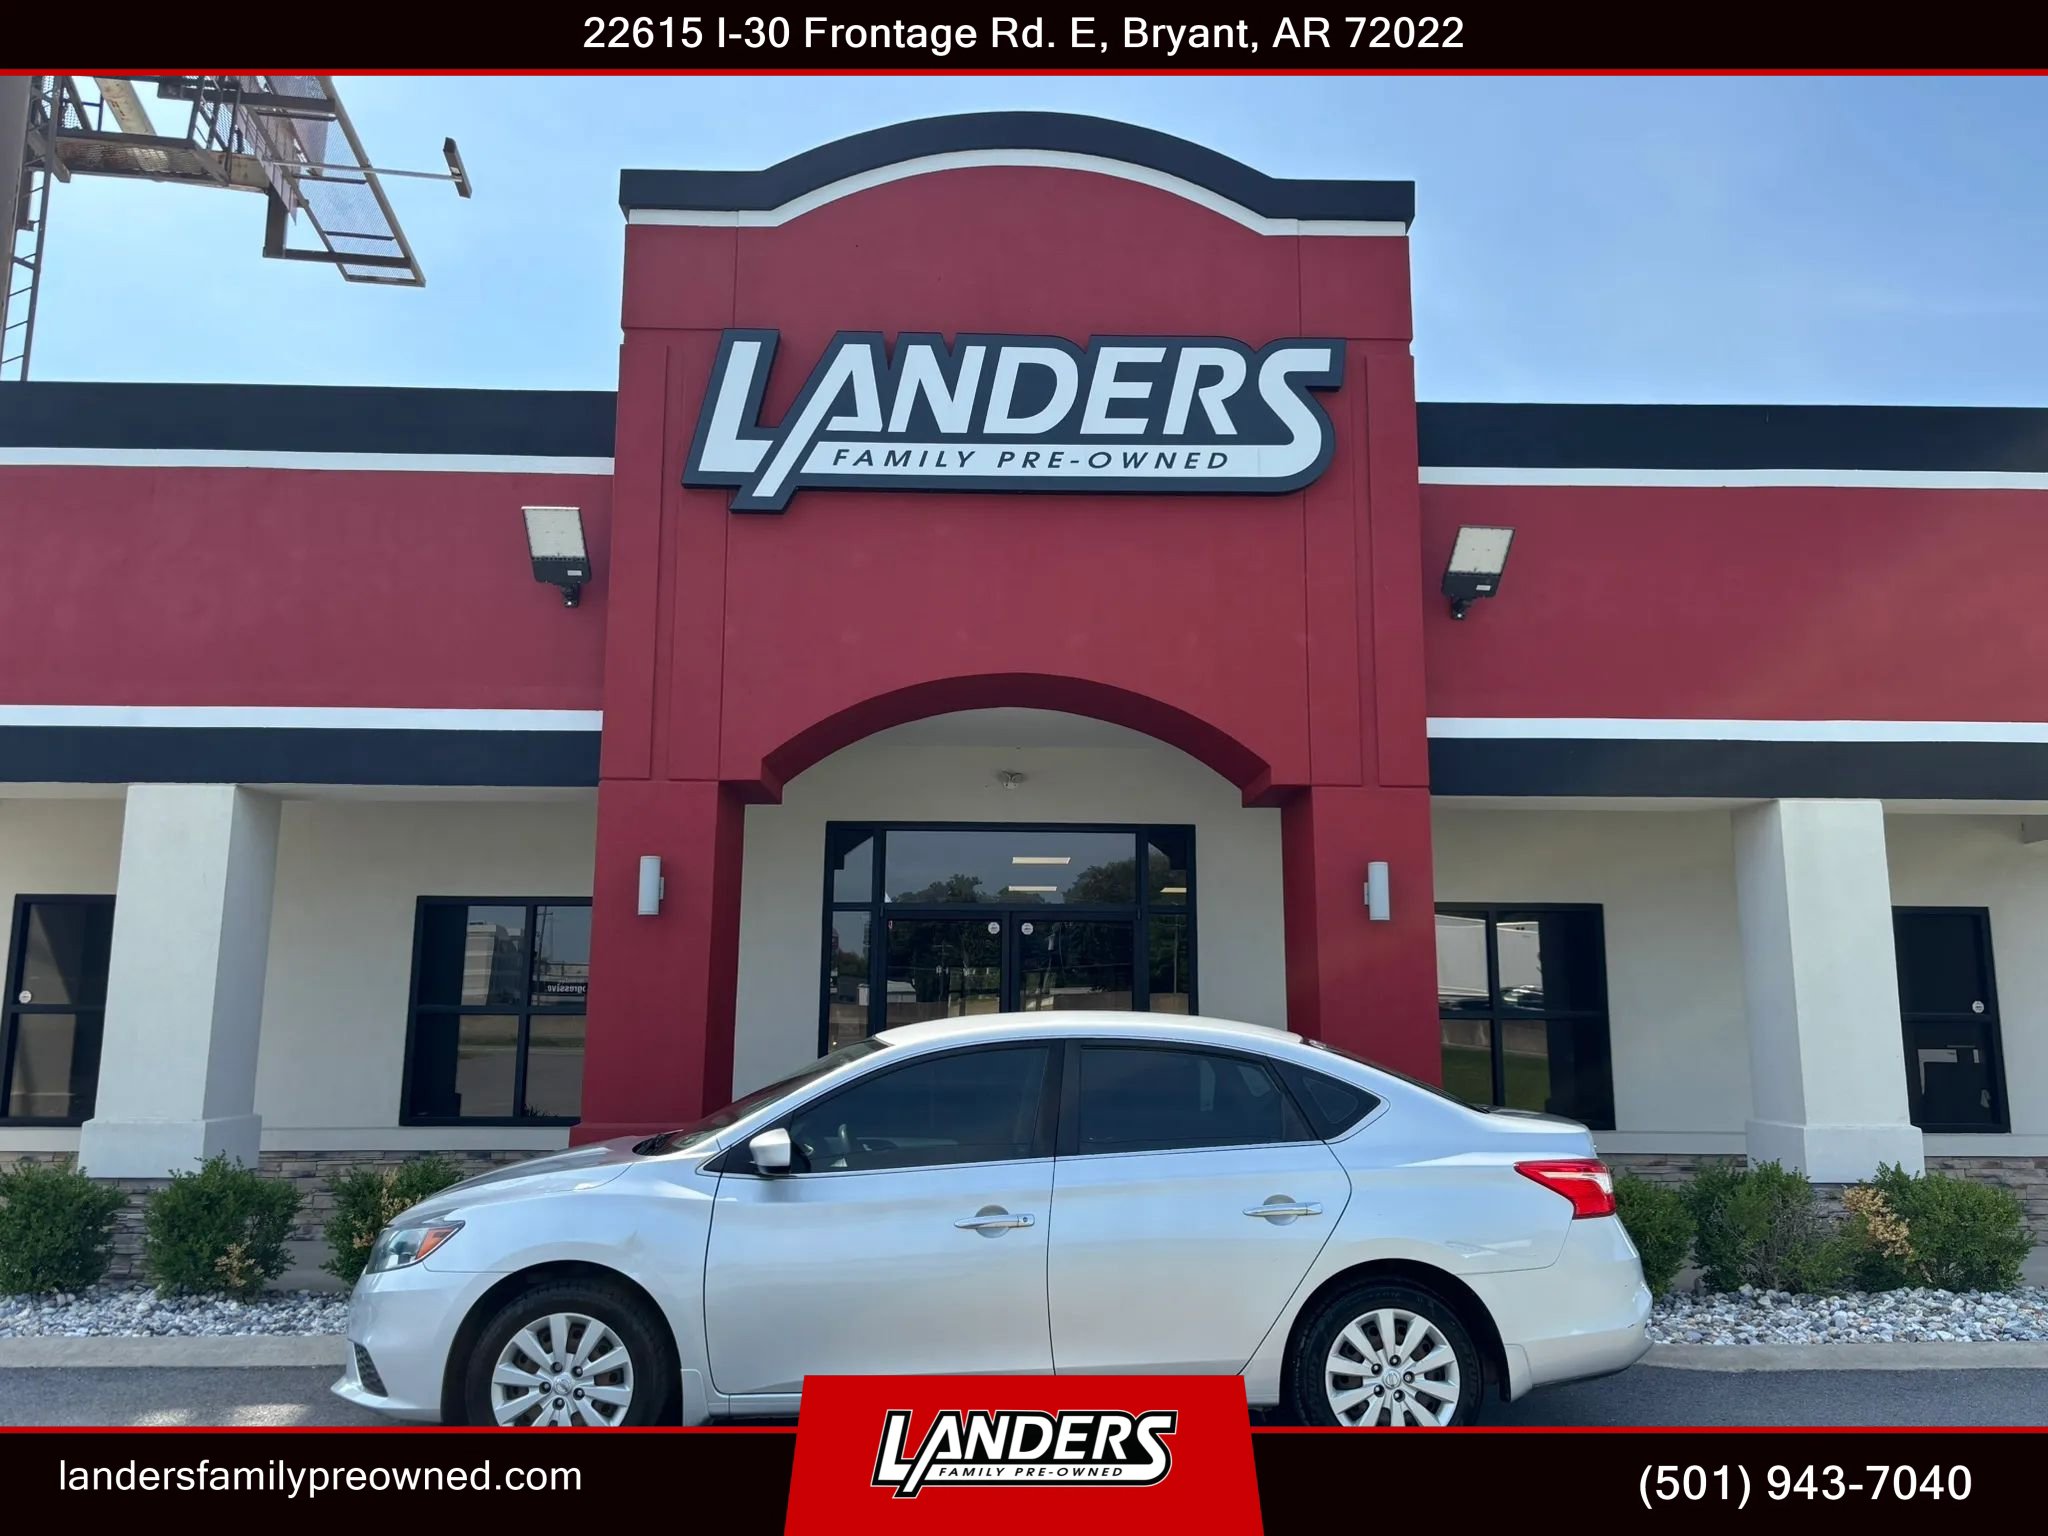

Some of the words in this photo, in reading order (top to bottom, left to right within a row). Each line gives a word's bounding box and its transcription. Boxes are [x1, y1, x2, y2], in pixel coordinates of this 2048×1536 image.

[698, 341, 1332, 497] LANDERS
[832, 447, 978, 469] FAMILY
[996, 449, 1230, 470] PRE-OWNED
